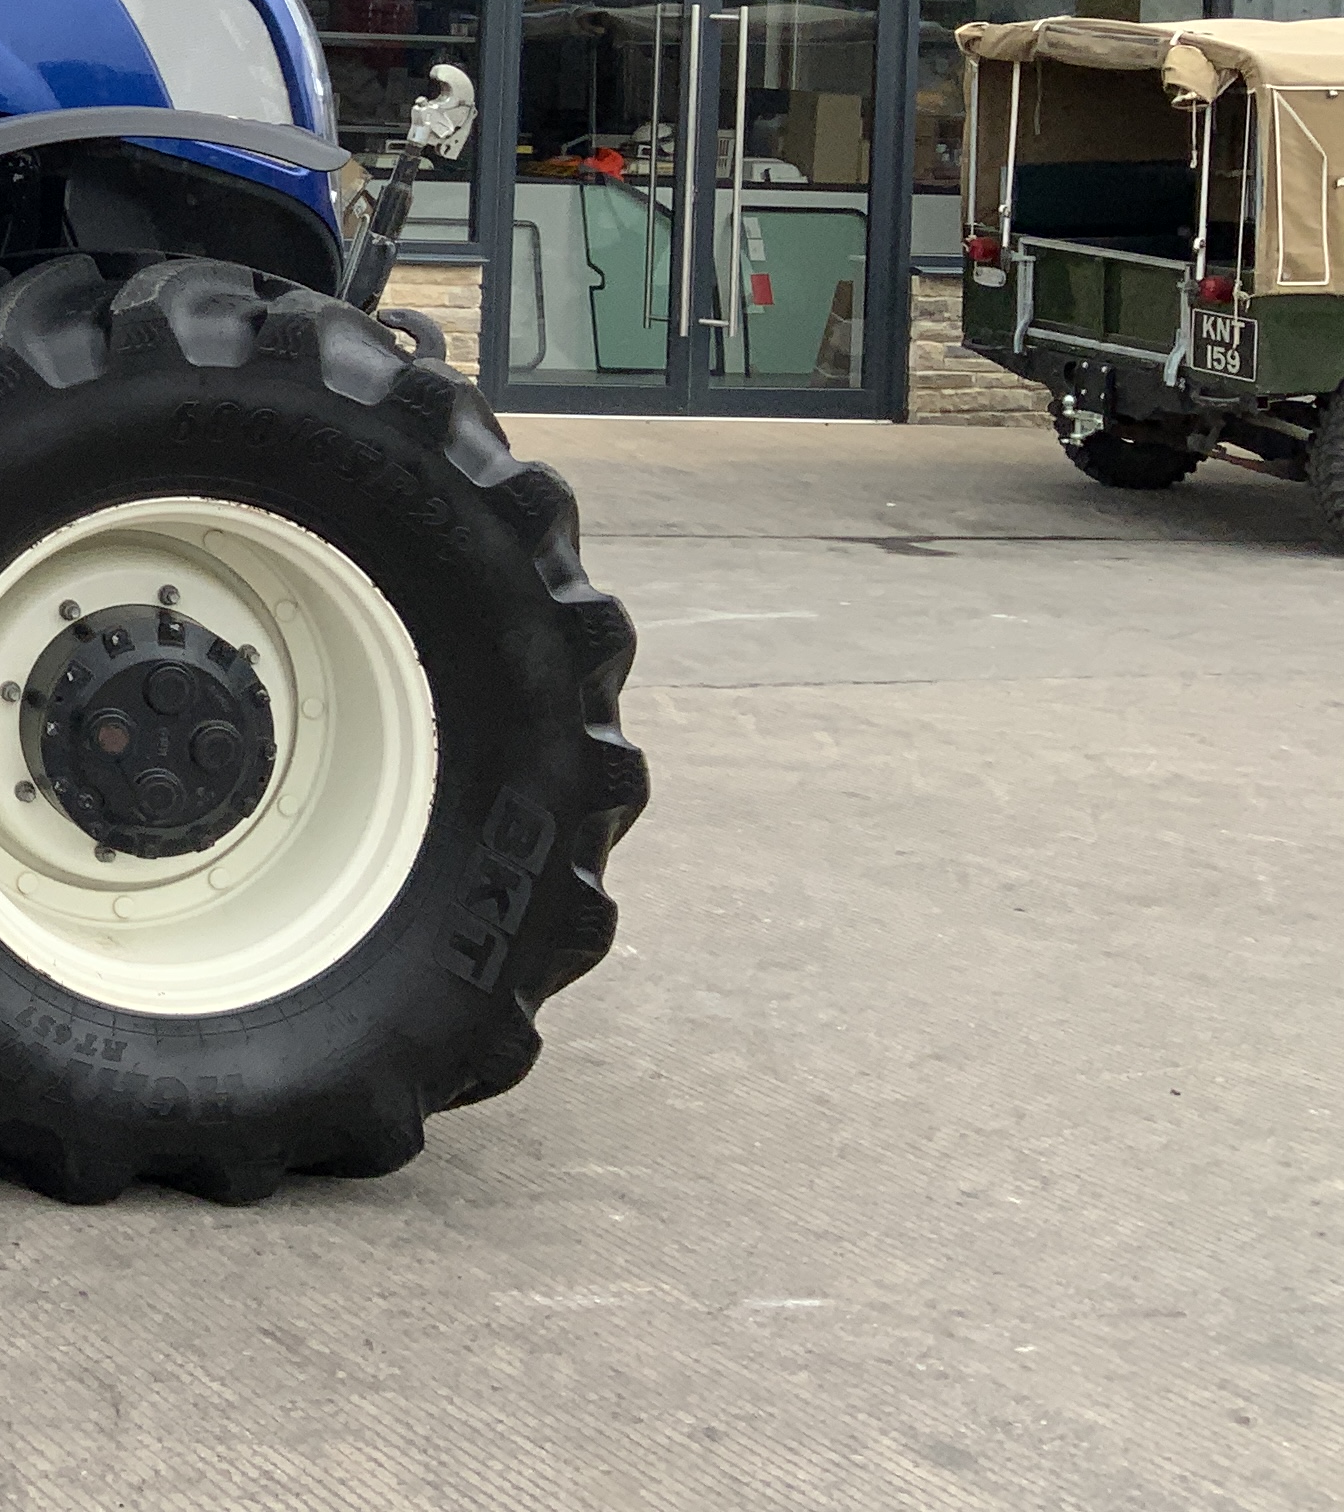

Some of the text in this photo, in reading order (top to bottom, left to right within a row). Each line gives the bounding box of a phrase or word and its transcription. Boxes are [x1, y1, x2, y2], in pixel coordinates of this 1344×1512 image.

[1202, 314, 1245, 345] KNT
[1206, 344, 1241, 374] 159
[437, 790, 554, 990] BKT
